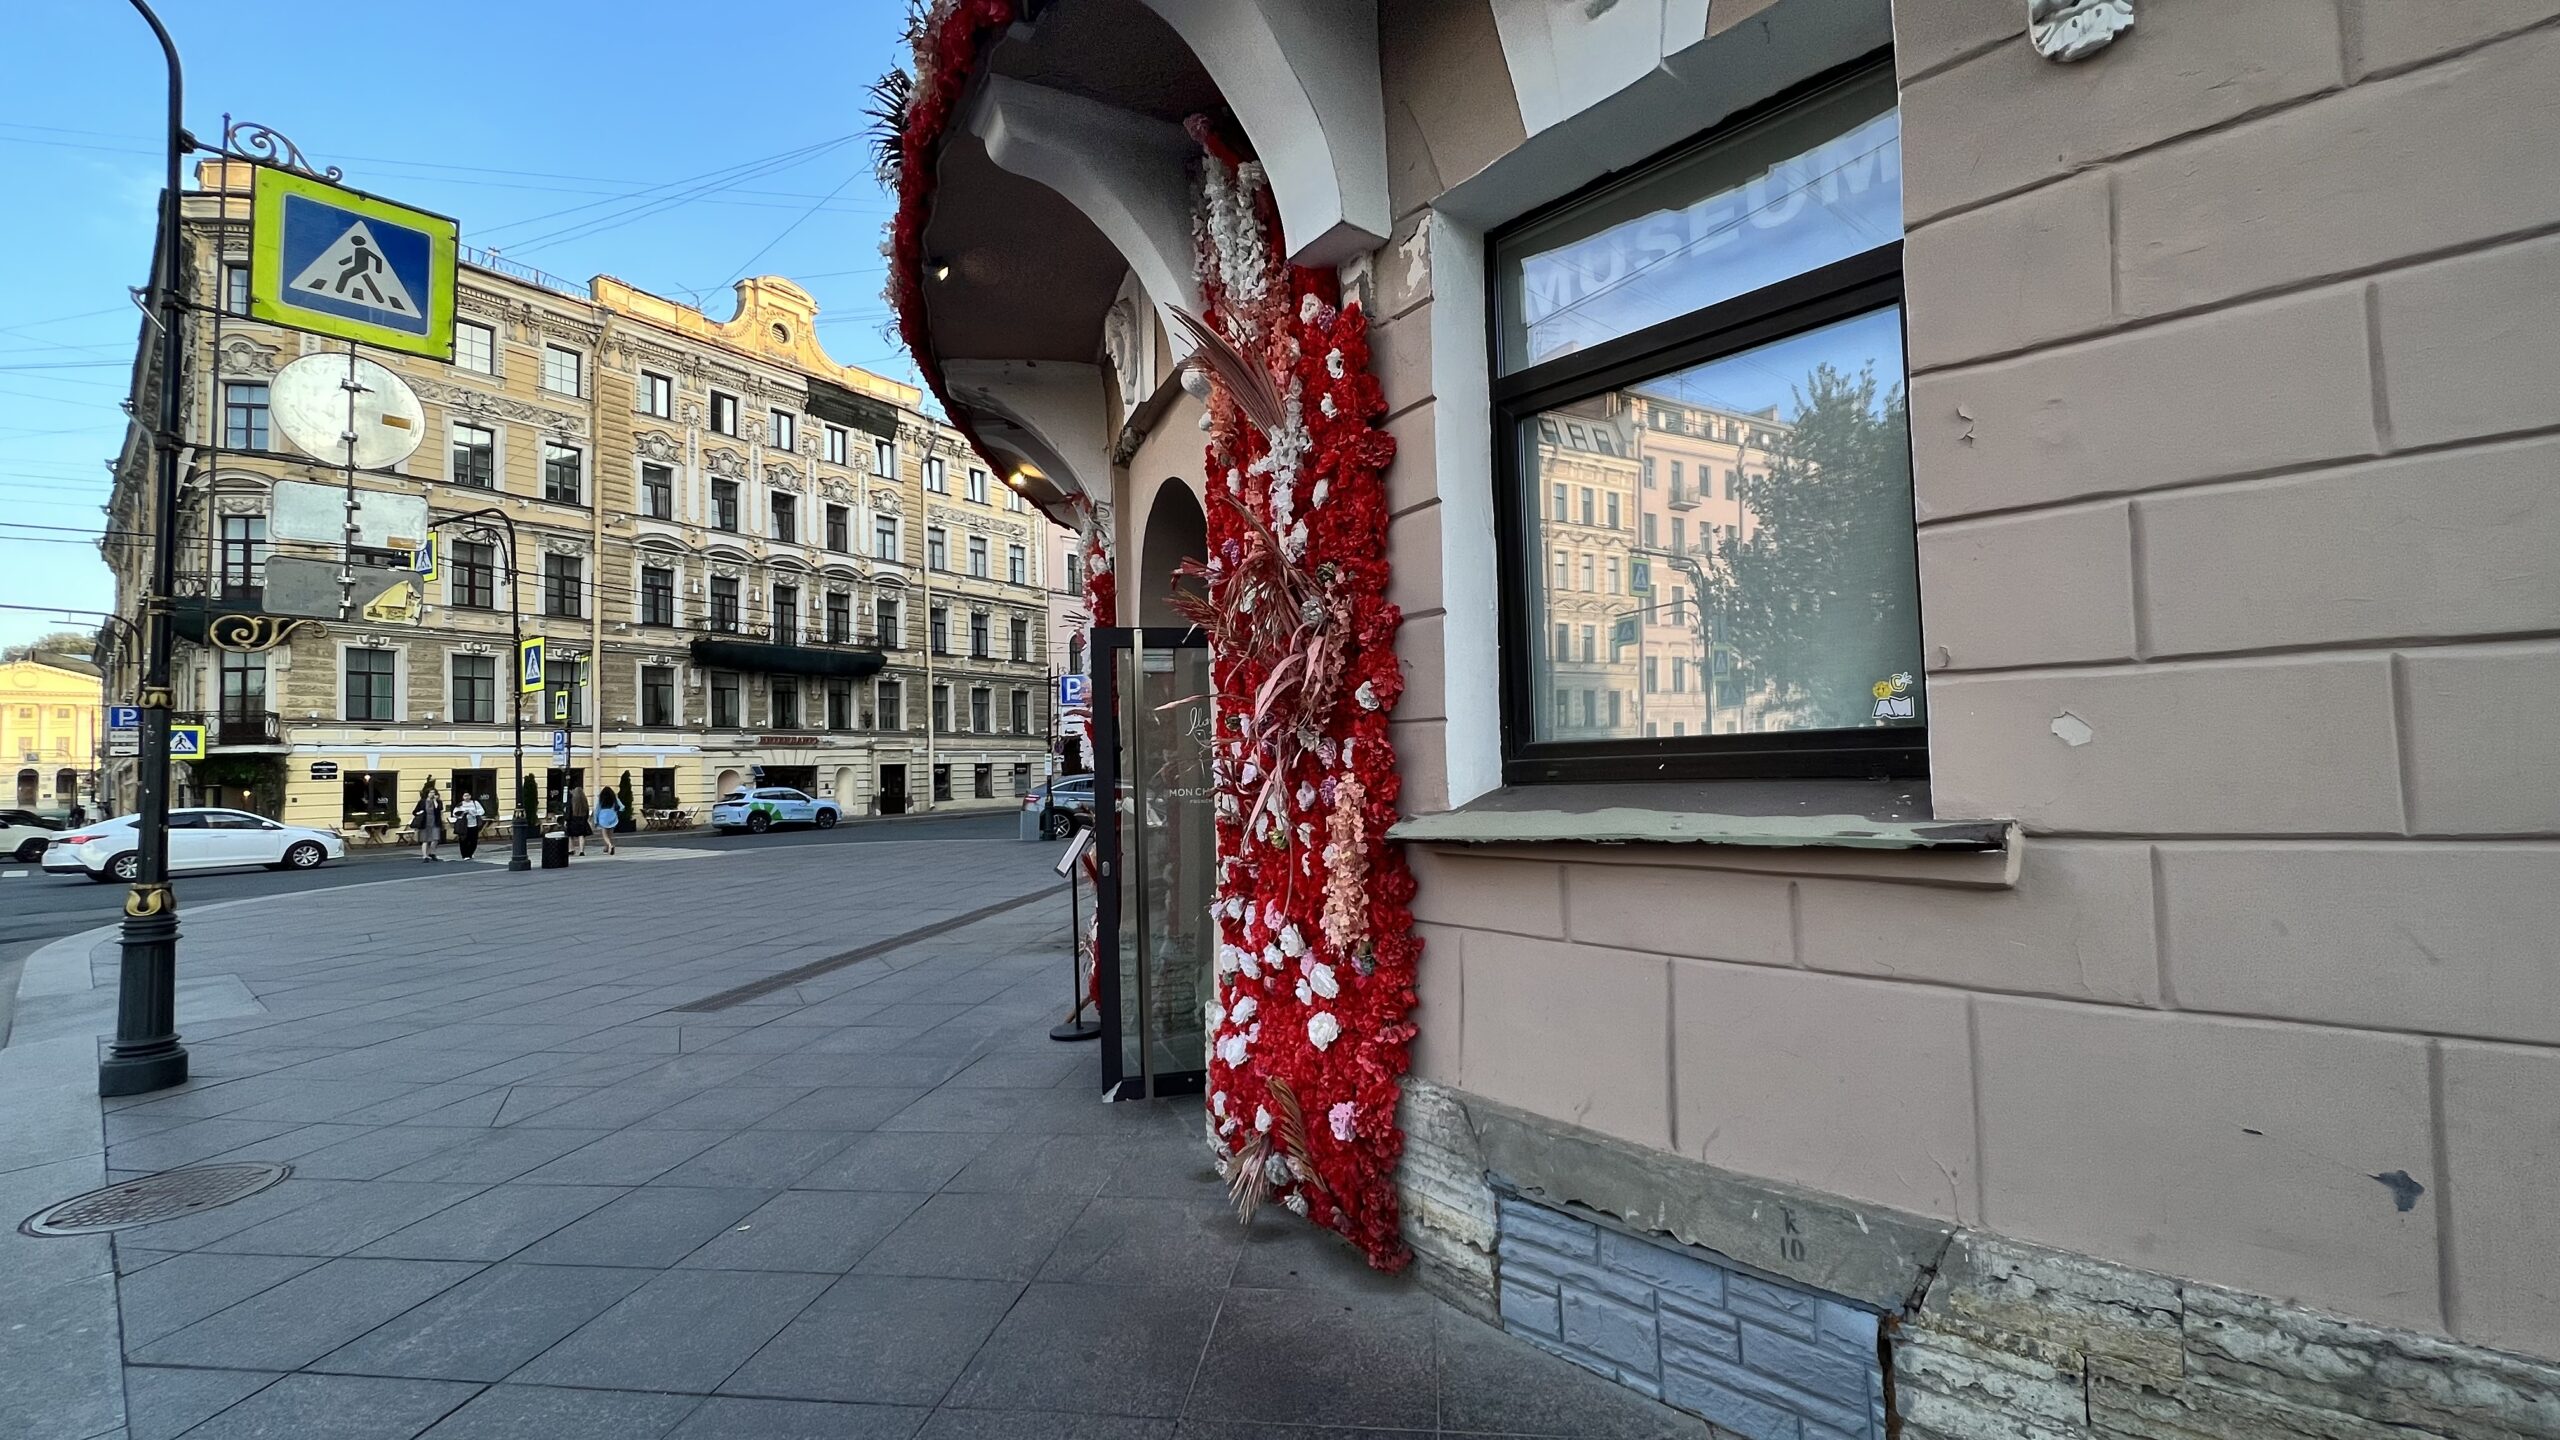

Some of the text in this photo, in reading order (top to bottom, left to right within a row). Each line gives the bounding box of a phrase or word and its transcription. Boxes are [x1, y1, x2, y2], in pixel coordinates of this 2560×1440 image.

[1518, 134, 1899, 326] MUSEUM
[1066, 677, 1081, 700] P
[119, 708, 137, 726] P
[1169, 788, 1193, 798] MON
